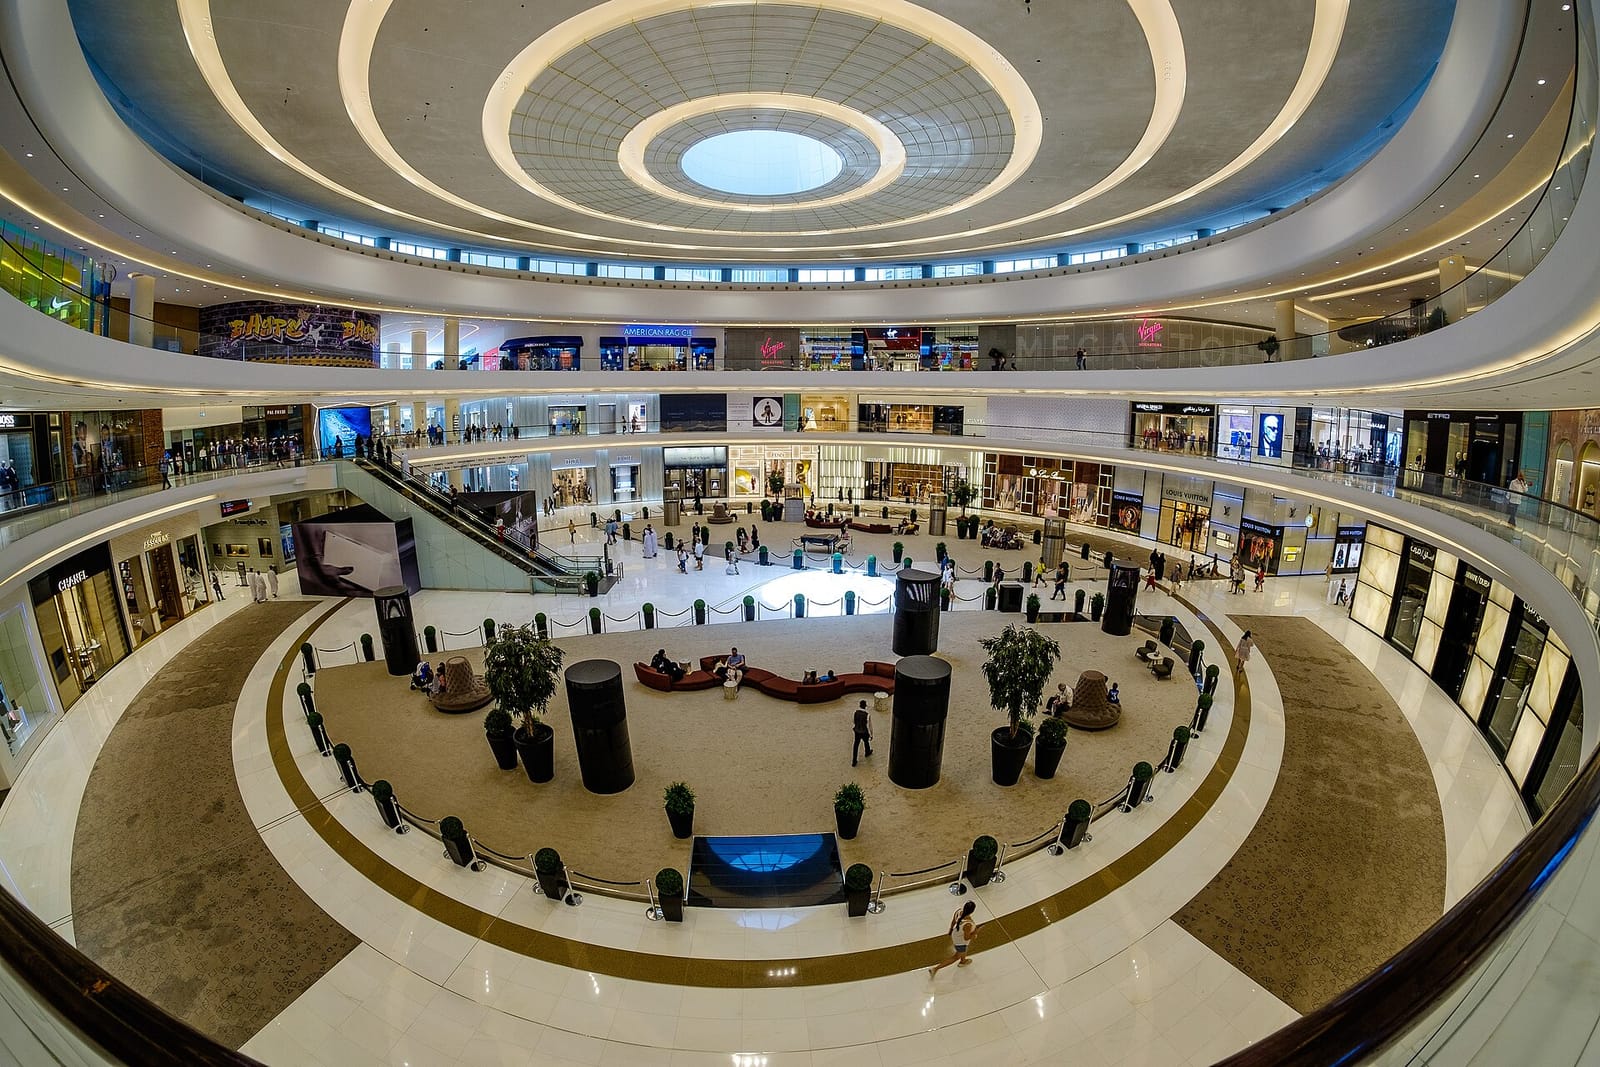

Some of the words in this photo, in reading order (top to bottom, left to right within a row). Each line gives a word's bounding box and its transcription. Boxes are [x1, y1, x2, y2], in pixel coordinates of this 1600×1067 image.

[623, 328, 664, 336] AMERICAN
[665, 329, 679, 337] RAG
[1137, 319, 1163, 341] Virgin
[761, 337, 785, 359] Virgin
[0, 415, 14, 424] OSS
[1165, 489, 1183, 498] LOUIS
[1184, 492, 1208, 502] VUITTON
[1242, 521, 1254, 529] LOUIS
[58, 570, 88, 592] CHANEL
